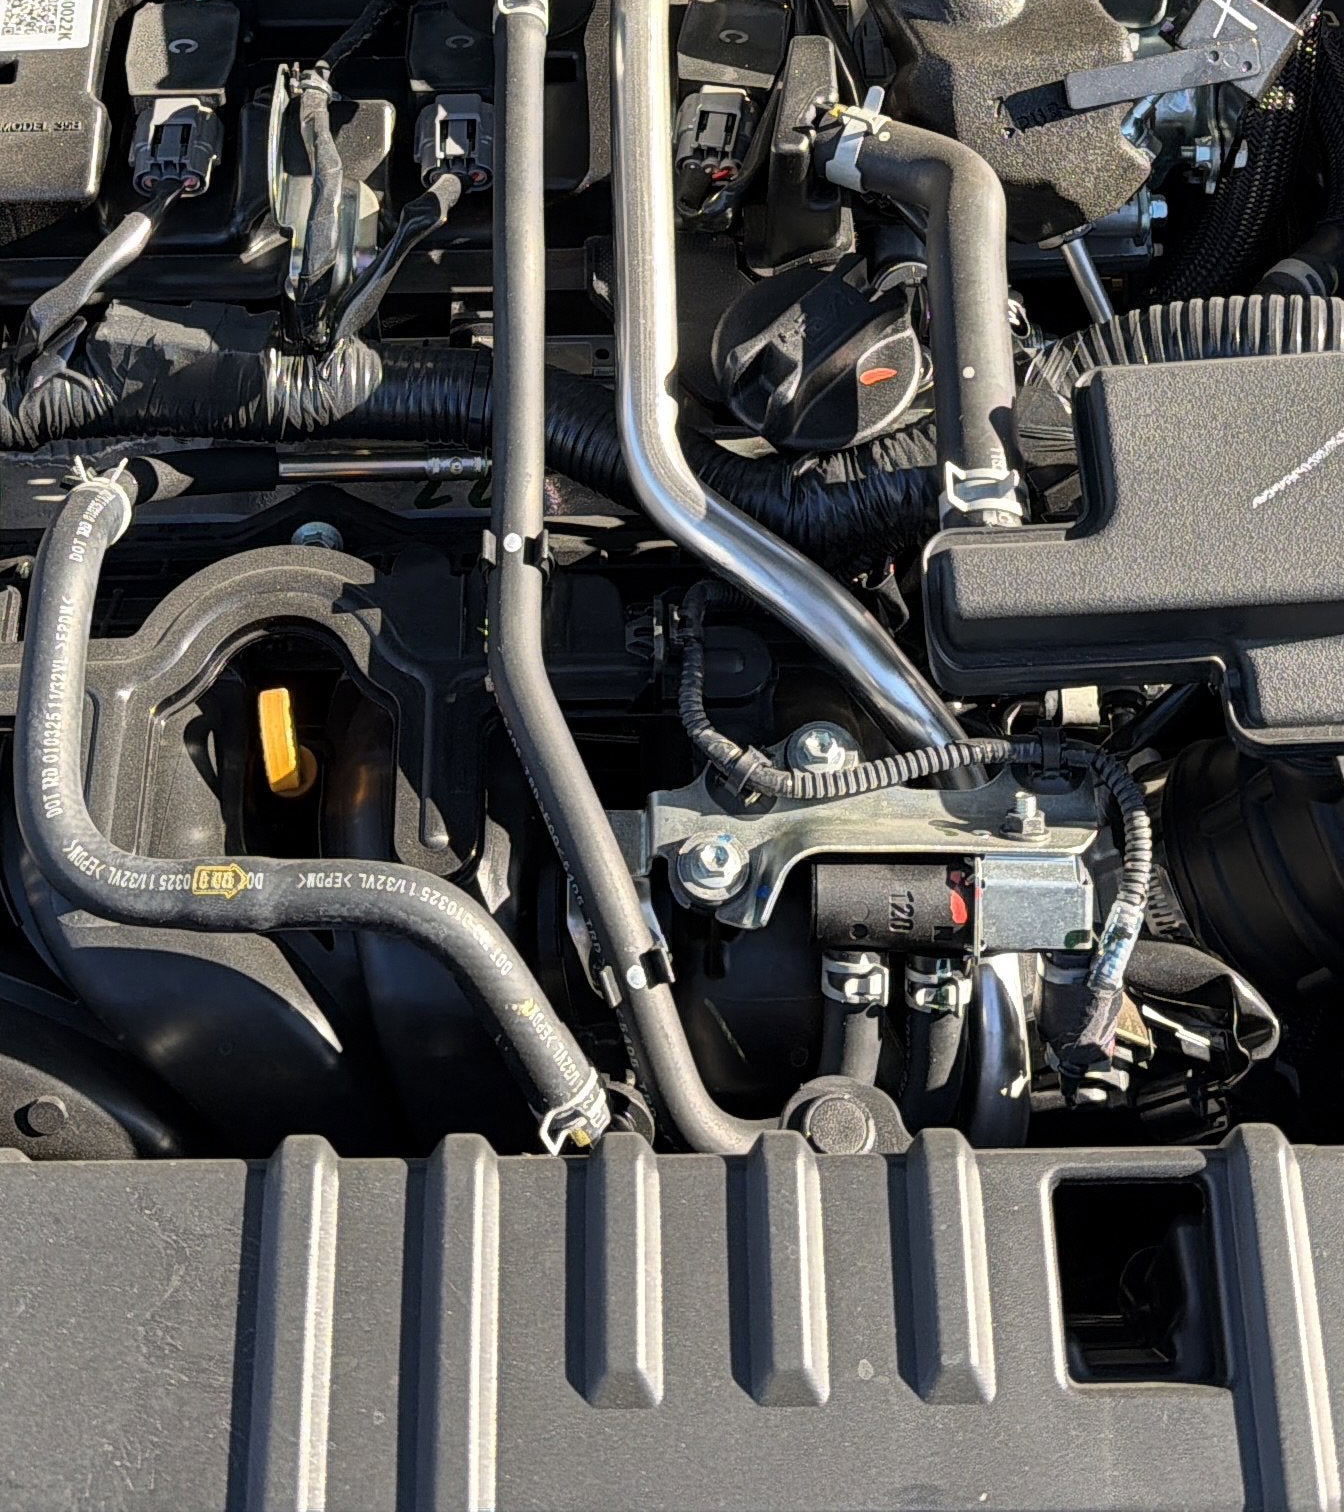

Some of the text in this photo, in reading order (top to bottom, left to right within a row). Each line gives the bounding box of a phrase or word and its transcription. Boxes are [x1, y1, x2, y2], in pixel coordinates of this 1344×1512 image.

[43, 712, 62, 763] 010325
[42, 794, 64, 819] DOT
[489, 948, 512, 975] DOT
